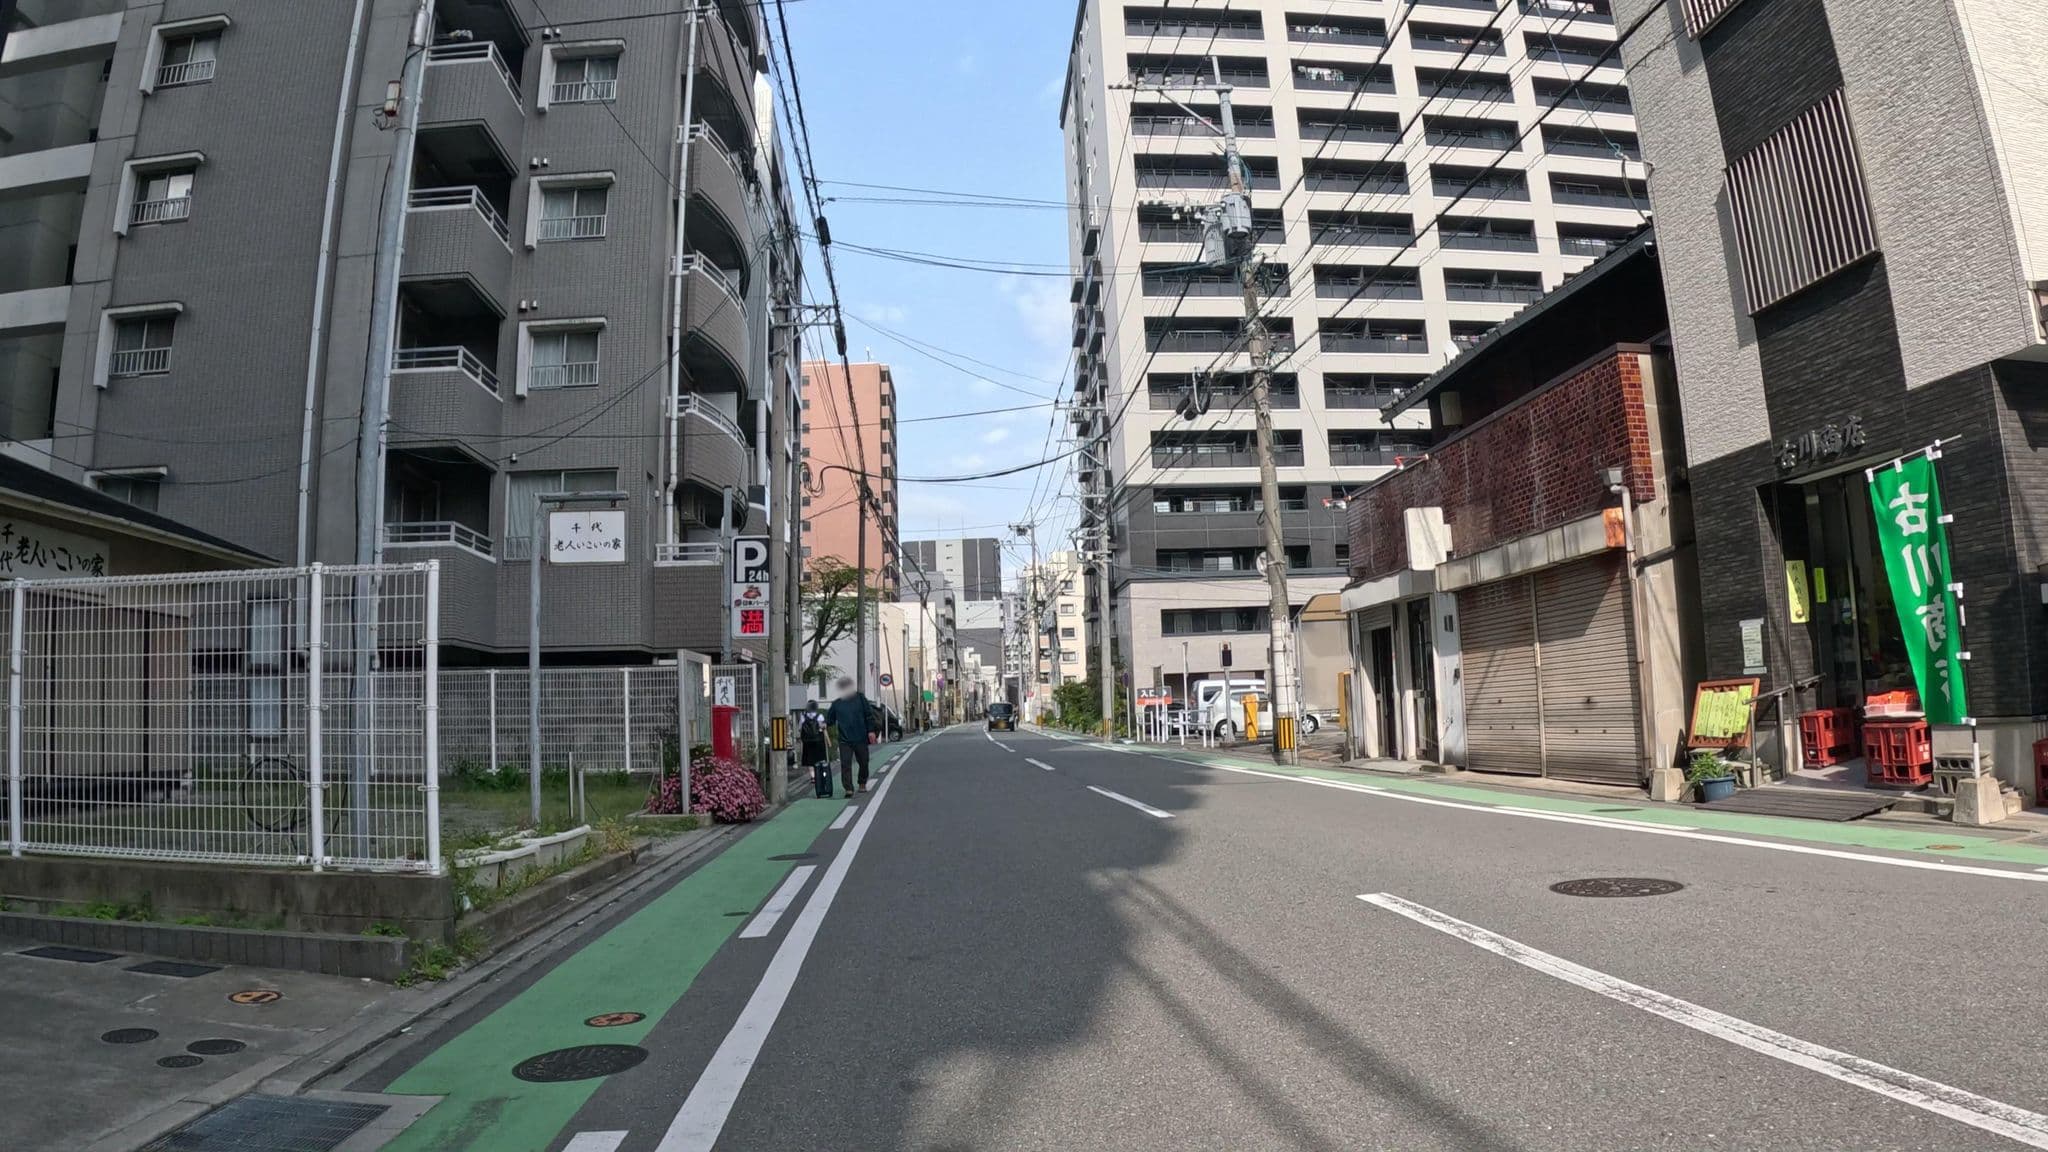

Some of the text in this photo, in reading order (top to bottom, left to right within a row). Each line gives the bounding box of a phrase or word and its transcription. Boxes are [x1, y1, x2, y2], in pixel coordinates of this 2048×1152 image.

[0, 523, 14, 573] 千代
[14, 536, 105, 577] 老人いこいの家
[553, 537, 622, 552] 老人いこいの家
[736, 540, 768, 582] P
[749, 570, 769, 582] 24h
[741, 610, 764, 633] 満
